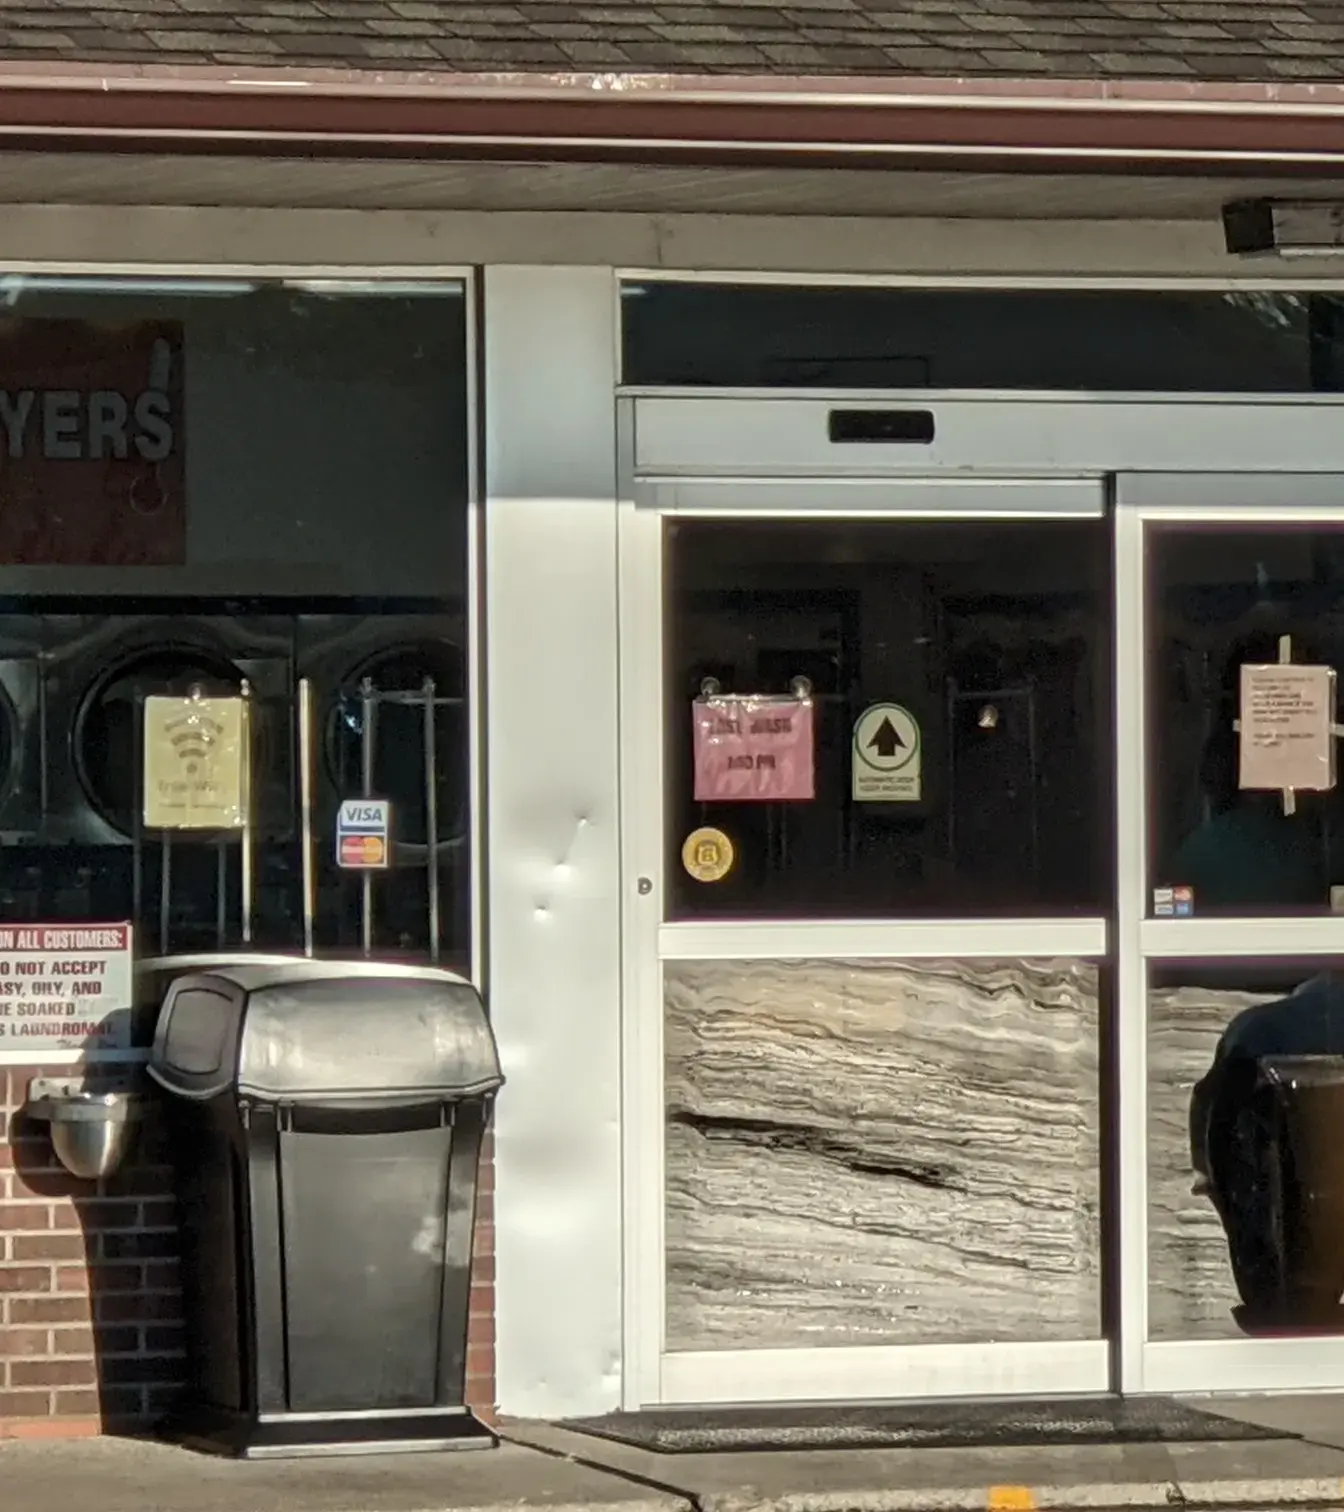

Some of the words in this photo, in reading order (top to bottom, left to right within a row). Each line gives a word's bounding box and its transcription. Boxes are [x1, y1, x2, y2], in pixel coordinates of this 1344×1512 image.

[0, 388, 173, 461] YERS
[346, 807, 383, 822] VISA
[16, 930, 41, 949] ALL
[44, 930, 124, 949] CUSTOMERS:
[15, 961, 46, 976] NOT
[51, 960, 107, 976] ACCEPT
[71, 981, 102, 995] AND
[17, 1002, 76, 1016] SOAKED
